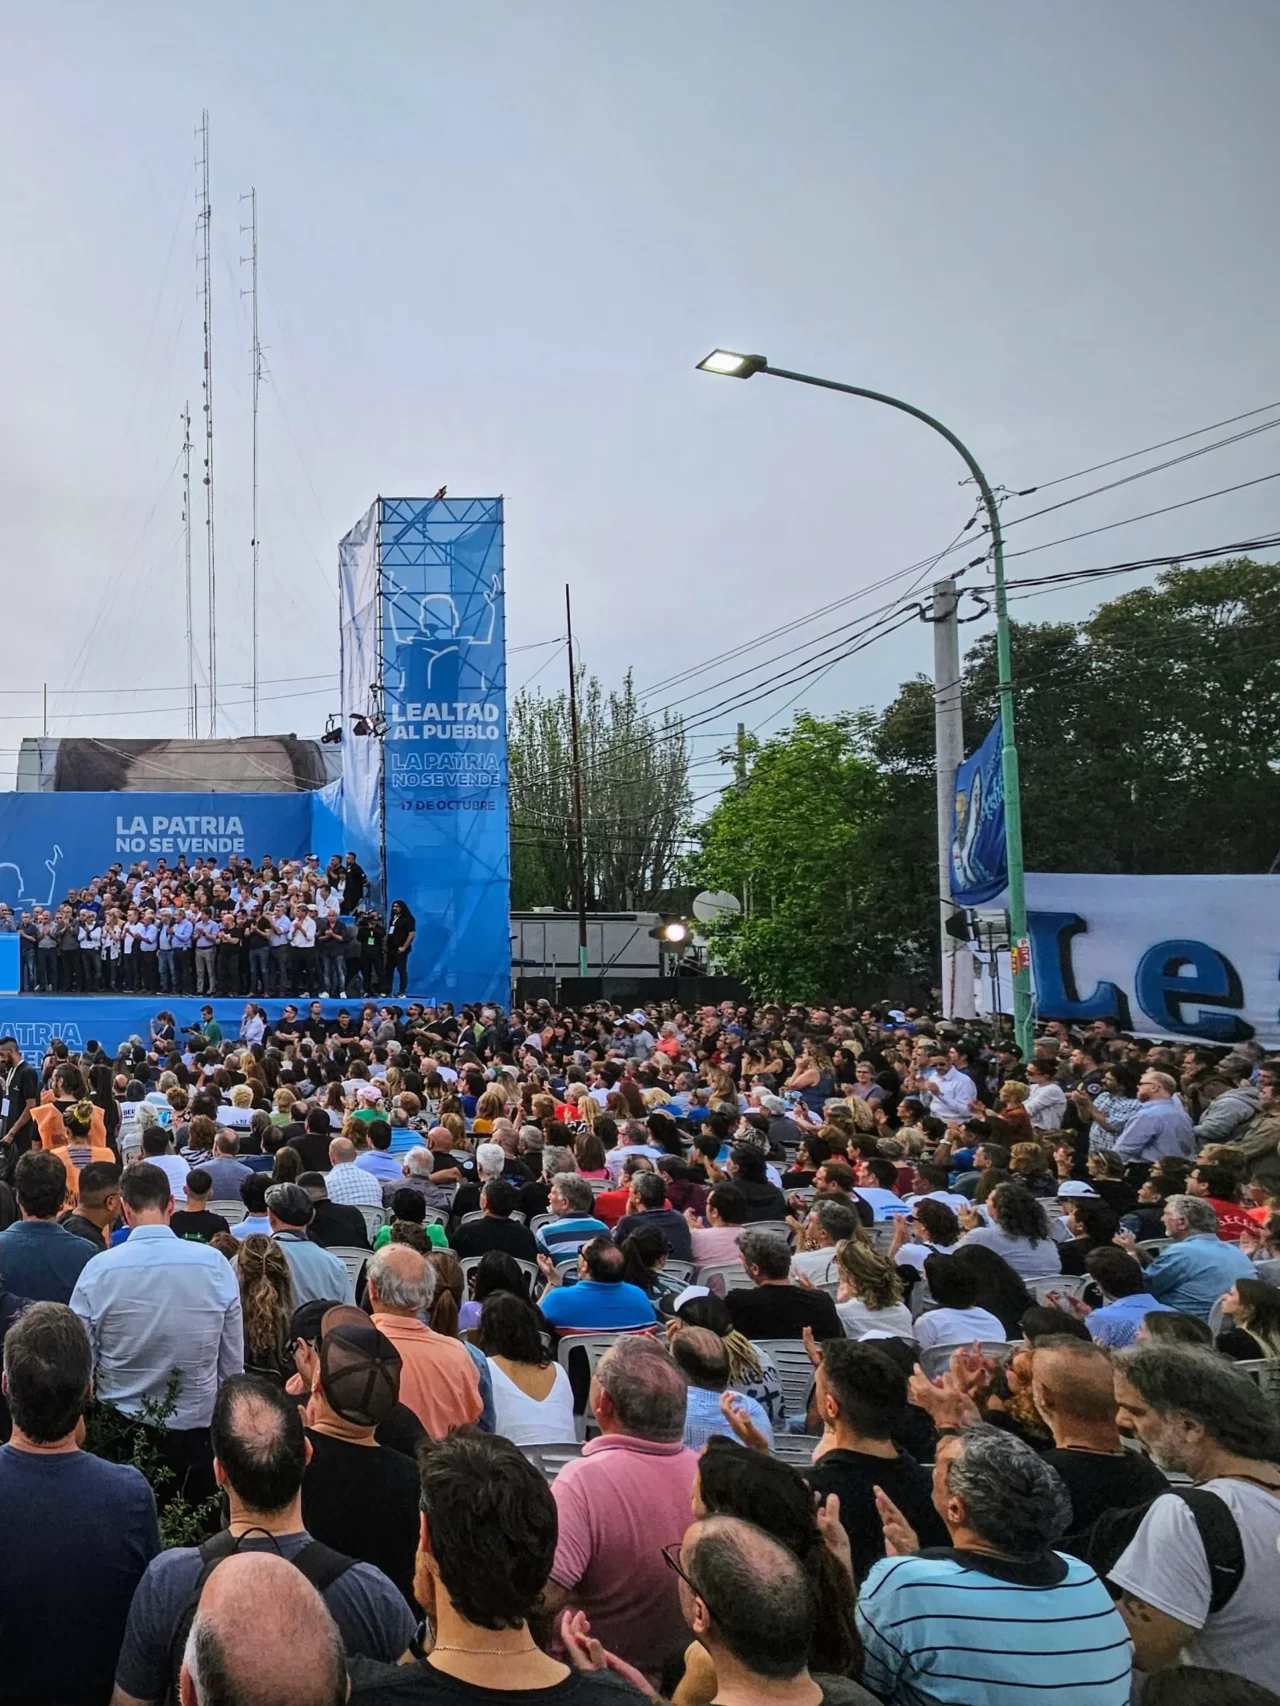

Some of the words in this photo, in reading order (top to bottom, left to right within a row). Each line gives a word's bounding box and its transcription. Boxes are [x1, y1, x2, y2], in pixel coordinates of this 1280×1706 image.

[391, 702, 500, 722] LEALTAD
[392, 725, 420, 740] AL
[423, 724, 500, 740] PUEBLO
[391, 753, 422, 771] LA
[424, 752, 500, 771] PATRIA
[392, 773, 421, 787] NO
[421, 772, 444, 787] SE
[444, 773, 501, 787] VENDE
[401, 801, 412, 811] 17
[415, 801, 434, 811] DE
[436, 800, 496, 811] OCTUBRE
[116, 816, 148, 835] LA
[152, 816, 244, 835] PATRIA
[115, 838, 146, 853] NO
[149, 838, 174, 853] SE
[176, 838, 245, 853] VENDE
